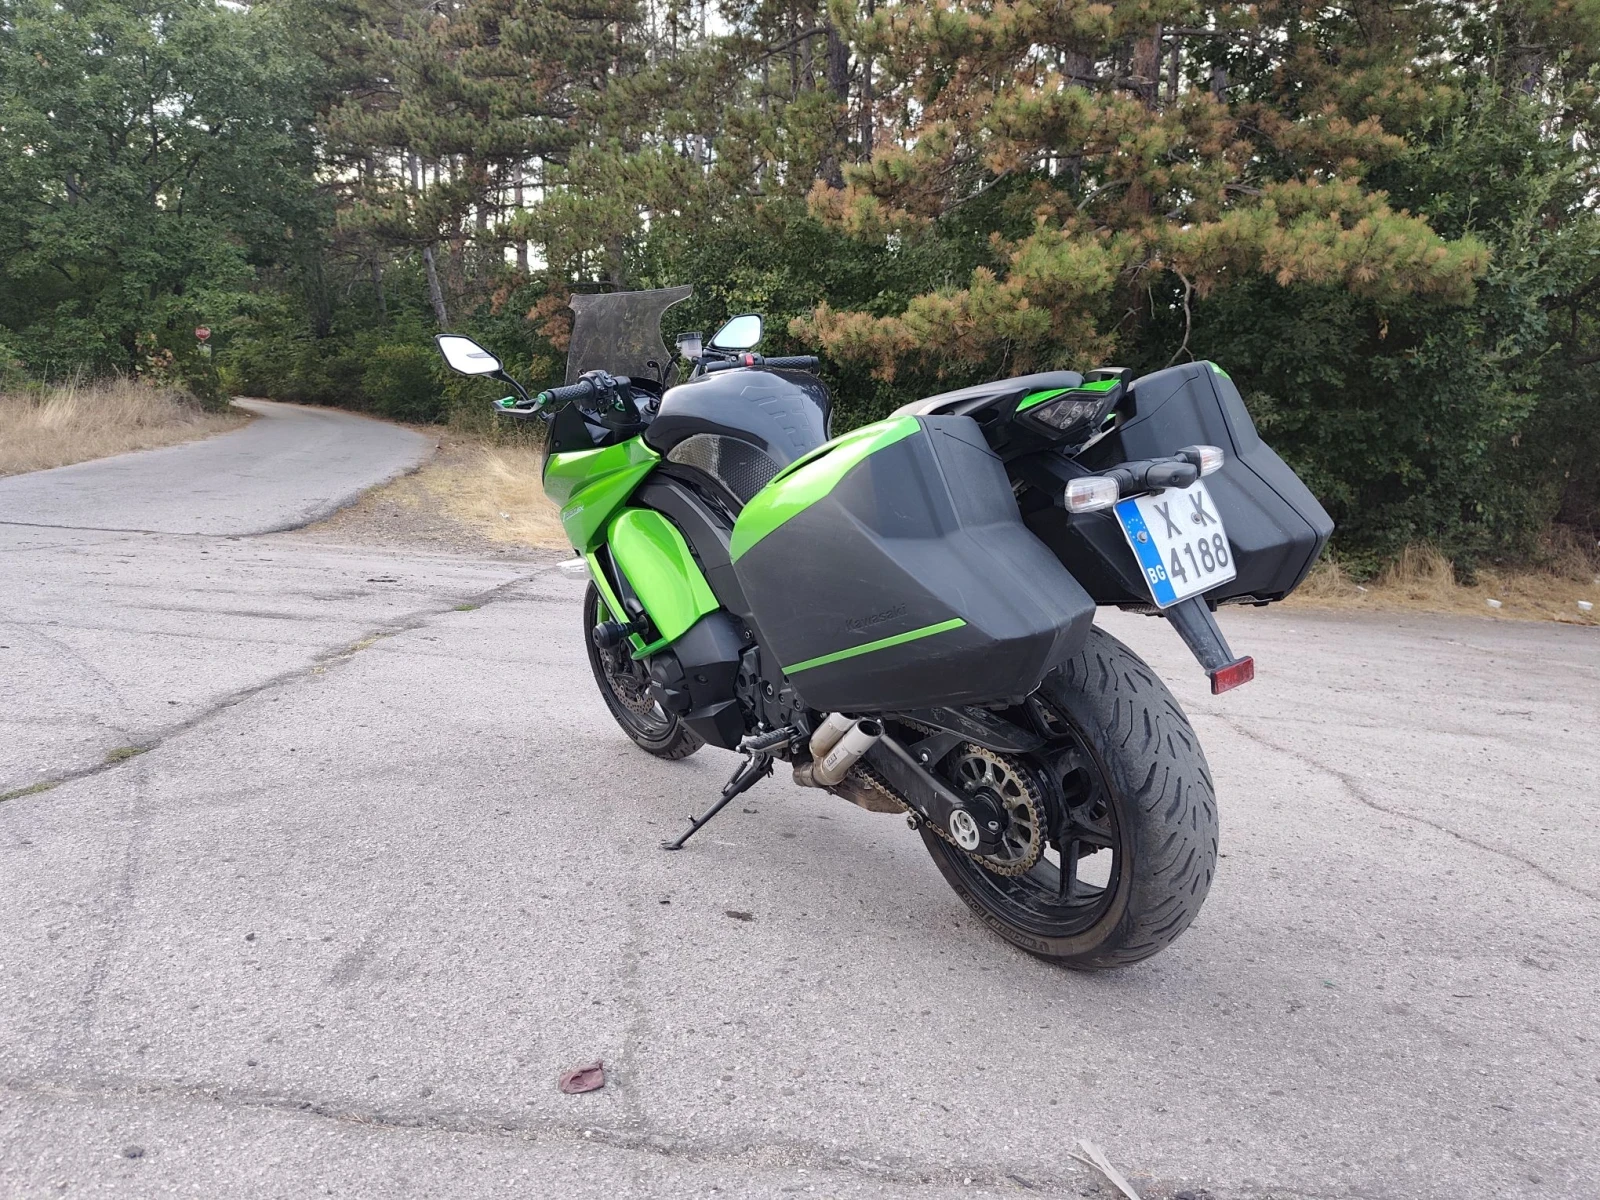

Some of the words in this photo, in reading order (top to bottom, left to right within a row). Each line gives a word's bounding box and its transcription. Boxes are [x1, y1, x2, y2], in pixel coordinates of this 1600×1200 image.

[1153, 501, 1182, 538] X
[1189, 491, 1217, 527] K
[1171, 533, 1228, 583] 4188
[1147, 565, 1166, 583] BG
[845, 603, 908, 631] Kawasaki
[963, 893, 984, 915] ROAD
[989, 918, 1035, 947] MICHELIN
